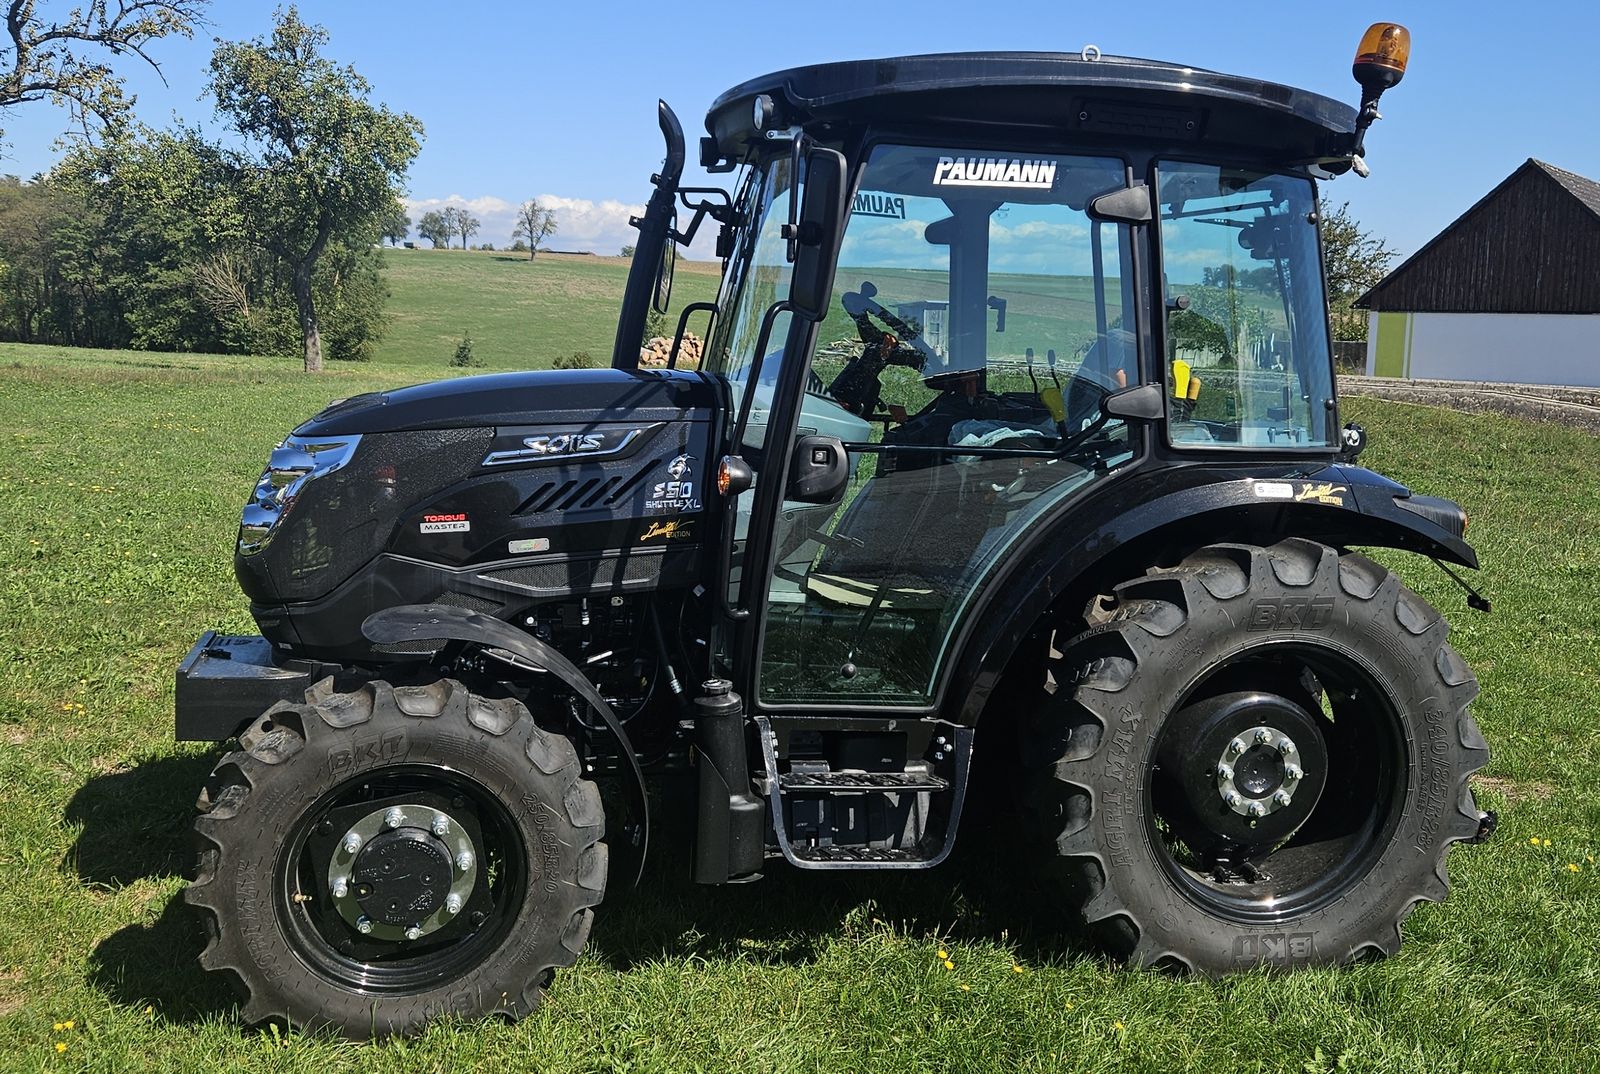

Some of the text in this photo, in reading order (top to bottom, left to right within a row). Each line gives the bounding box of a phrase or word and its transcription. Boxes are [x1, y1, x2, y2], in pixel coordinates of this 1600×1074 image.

[933, 156, 1056, 186] PAUMANN
[424, 514, 465, 522] TORQUE
[666, 531, 691, 539] EDITION
[1251, 600, 1335, 630] BKT
[1102, 702, 1143, 868] AGRI MAX
[1234, 934, 1313, 963] BKT
